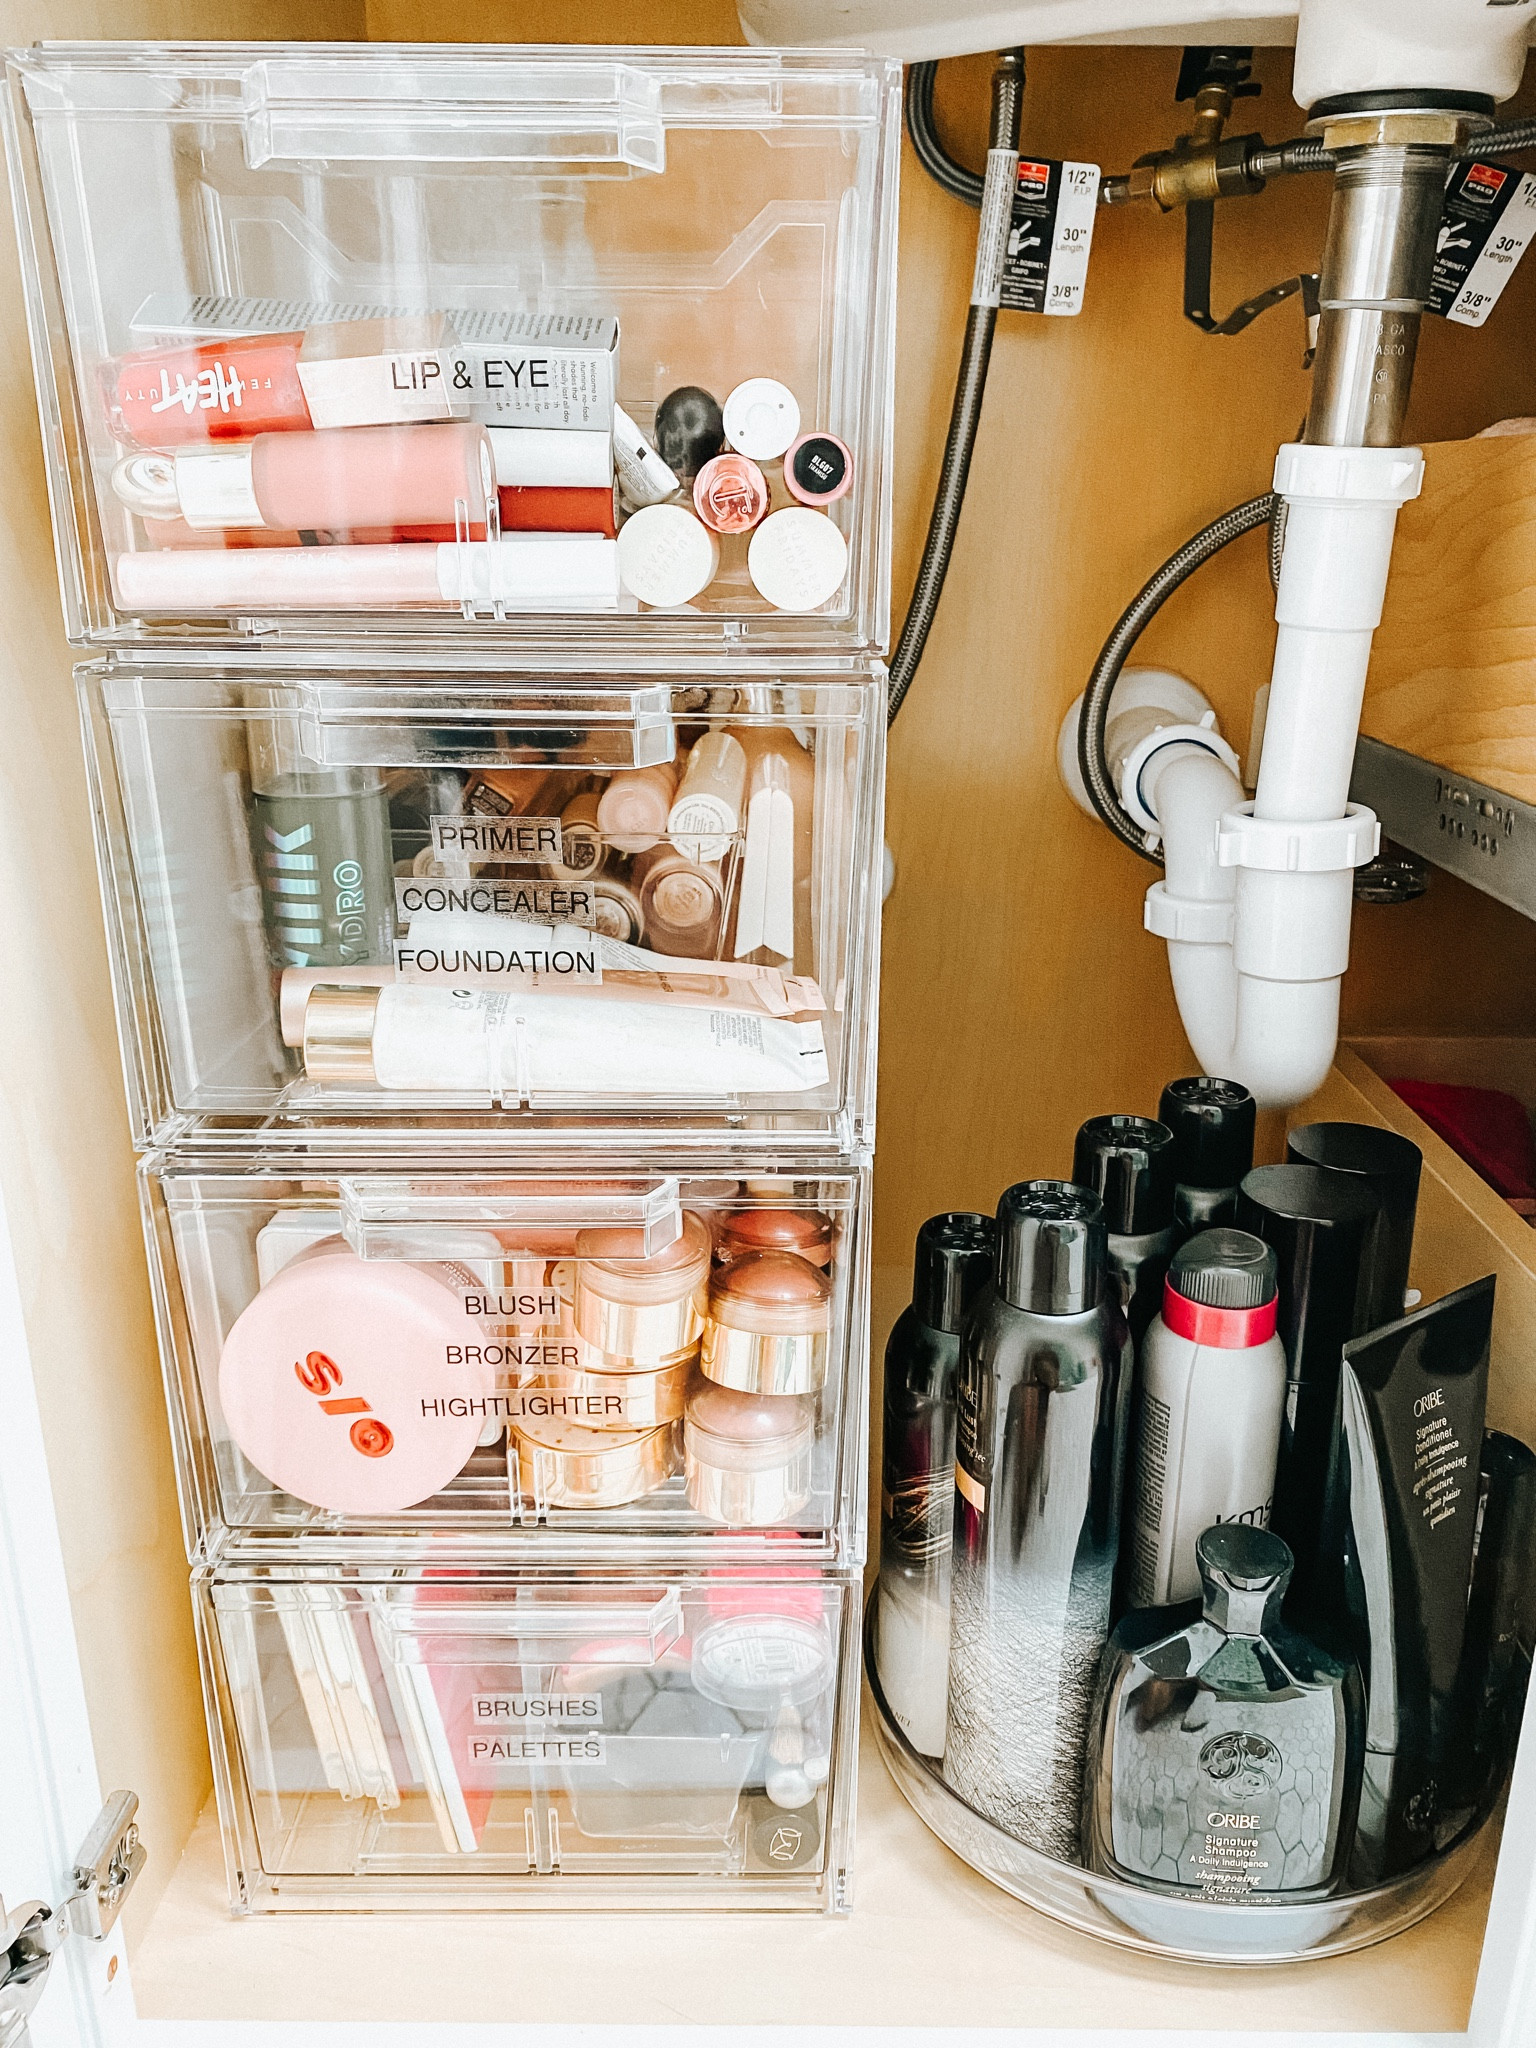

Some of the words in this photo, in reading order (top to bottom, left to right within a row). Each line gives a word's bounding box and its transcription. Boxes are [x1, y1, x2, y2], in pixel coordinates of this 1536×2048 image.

[1068, 169, 1095, 185] 1/2"
[1063, 228, 1087, 242] 30"
[1055, 243, 1084, 254] Length
[1496, 236, 1523, 252] 30"
[1484, 248, 1513, 264] Length
[1052, 285, 1079, 298] 3/8"
[1462, 290, 1492, 307] 3/8"
[391, 361, 441, 390] LIP
[452, 360, 474, 389] &
[484, 359, 549, 389] EYE
[590, 361, 598, 394] Welcome
[151, 361, 242, 414] HEAT
[591, 395, 598, 403] to
[438, 826, 557, 852] PRIMER
[402, 887, 590, 915] CONCEALER
[398, 949, 596, 974] FOUNDATION
[465, 1295, 557, 1316] BLUSH
[446, 1345, 579, 1366] BRONZER
[420, 1395, 623, 1418] HIGHTLIGHTER
[1413, 1388, 1445, 1418] ORIBE
[1416, 1416, 1447, 1440] Signature
[1415, 1427, 1453, 1455] Conditioner
[1428, 1439, 1459, 1460] Indulgence
[477, 1700, 598, 1717] BRUSHES
[473, 1741, 600, 1758] PALETTES
[1207, 1812, 1261, 1830] ORIBE
[1205, 1834, 1259, 1848] Signature
[1204, 1845, 1257, 1858] Shampoo
[1189, 1855, 1197, 1863] A
[1198, 1856, 1221, 1867] Daily
[1222, 1859, 1269, 1869] Indulgence
[1195, 1870, 1261, 1886] shampooing
[1201, 1883, 1252, 1895] signature
